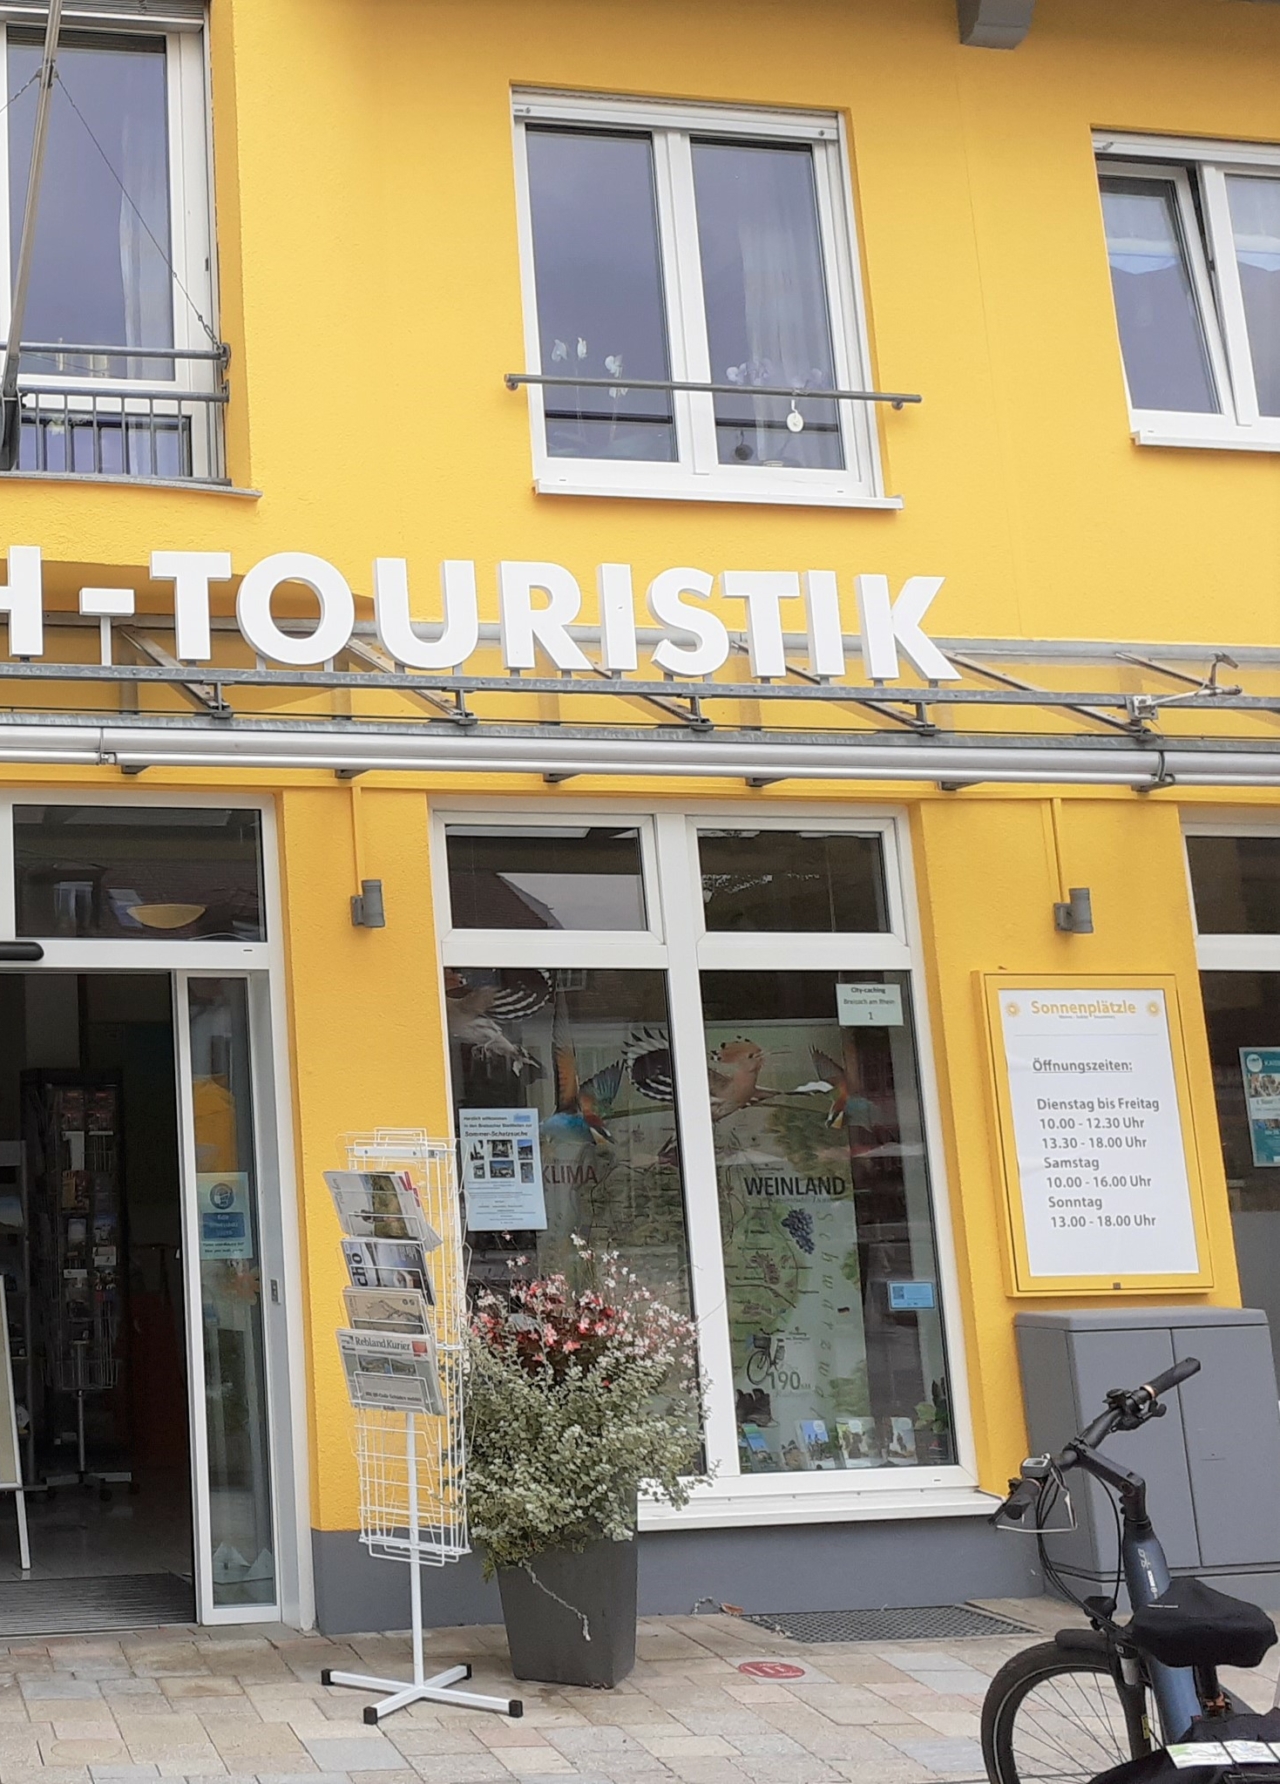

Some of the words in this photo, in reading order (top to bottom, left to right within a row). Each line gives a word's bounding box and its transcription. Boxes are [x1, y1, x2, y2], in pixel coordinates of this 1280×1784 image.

[1031, 1000, 1136, 1017] Sonnenplätzle
[868, 1012, 873, 1020] 1
[1032, 1057, 1133, 1073] Öffnungszeiten:
[1037, 1098, 1095, 1112] Dienstag
[1097, 1098, 1116, 1110] bis
[1118, 1098, 1160, 1112] Freitag
[1040, 1118, 1075, 1129] 10.00
[1086, 1118, 1120, 1129] 12.30
[1123, 1117, 1145, 1129] Uhr
[1042, 1138, 1077, 1149] 13.30
[1089, 1137, 1122, 1149] 18.00
[1126, 1136, 1147, 1148] Uhr
[1044, 1157, 1100, 1171] Samstag
[744, 1177, 846, 1196] WEINLAND
[1047, 1177, 1082, 1188] 10.00
[1093, 1176, 1127, 1188] 16.00
[1130, 1175, 1151, 1187] Uhr
[1048, 1196, 1103, 1210] Sonntag
[1051, 1216, 1086, 1228] 13.00
[1097, 1215, 1131, 1227] 18.00
[1135, 1215, 1156, 1226] Uhr
[355, 1337, 386, 1348] Rebland
[386, 1340, 411, 1351] Kurier
[769, 1371, 801, 1390] 190
